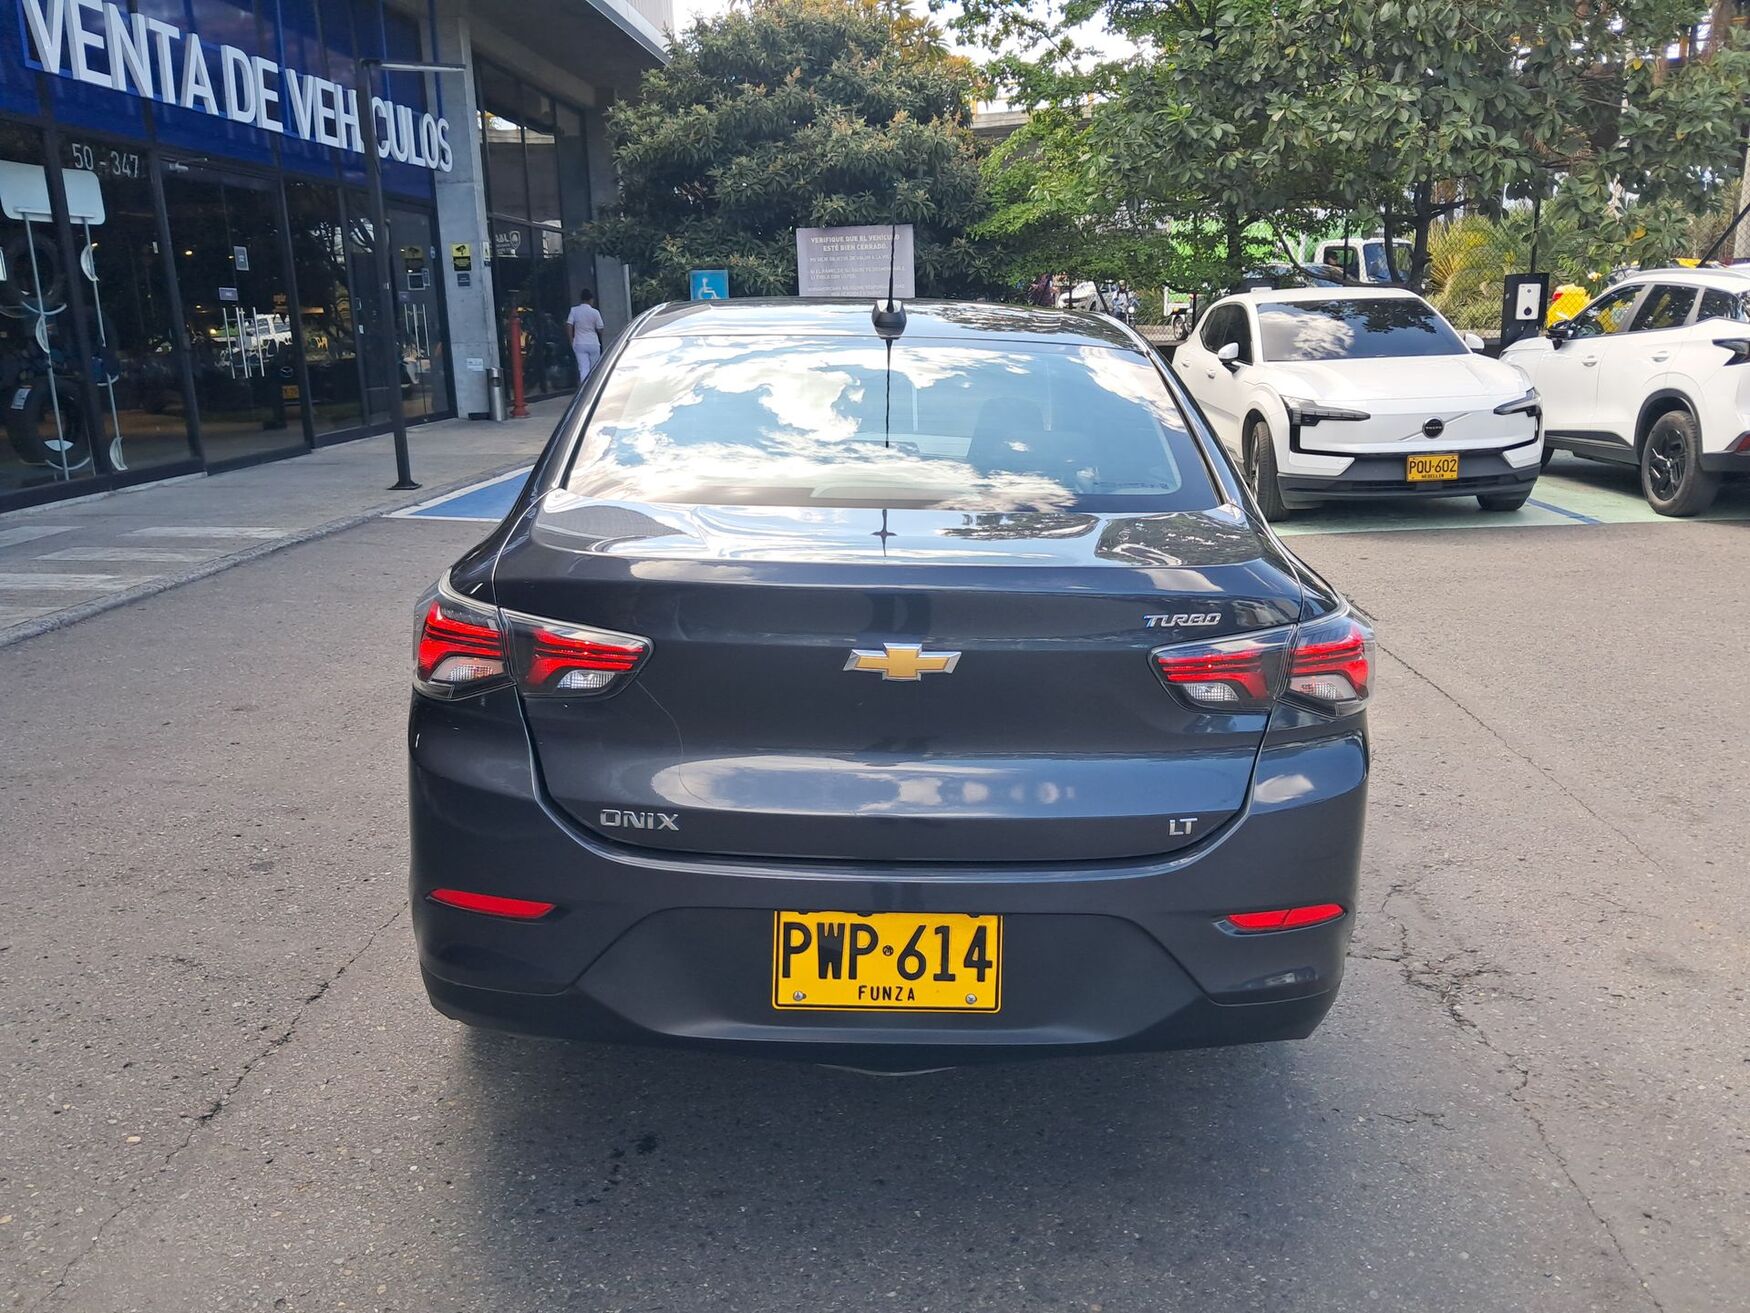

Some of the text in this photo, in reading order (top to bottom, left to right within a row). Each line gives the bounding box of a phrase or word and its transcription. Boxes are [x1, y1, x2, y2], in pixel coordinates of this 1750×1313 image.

[24, 0, 454, 173] VENTA DE VEHCULOS
[72, 143, 94, 170] 50
[110, 150, 139, 178] 347
[845, 234, 859, 242] QUE
[859, 234, 868, 242] EL
[868, 233, 900, 241] VEHÍCUO
[1143, 612, 1222, 628] TURBO
[600, 808, 680, 831] ONIX
[1169, 817, 1198, 836] LT
[858, 985, 916, 1002] FUNZA
